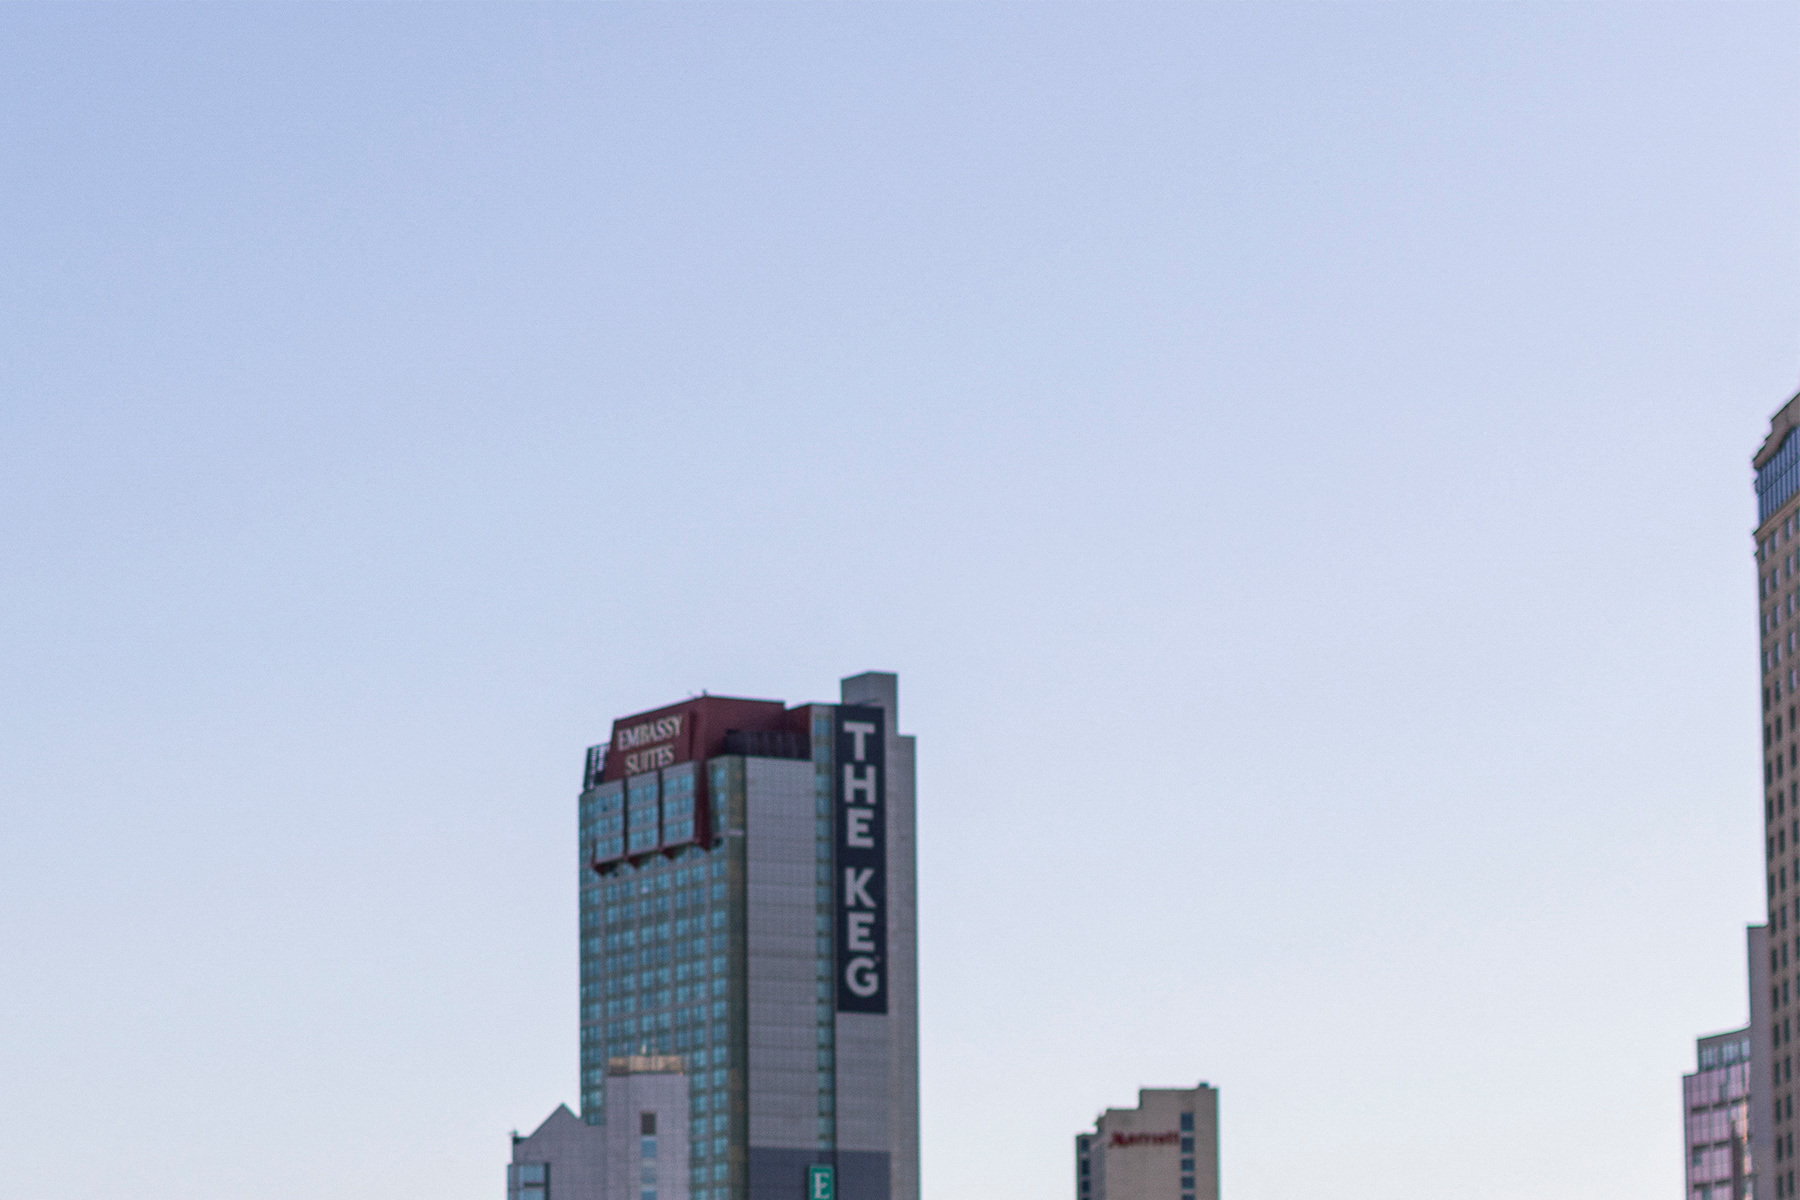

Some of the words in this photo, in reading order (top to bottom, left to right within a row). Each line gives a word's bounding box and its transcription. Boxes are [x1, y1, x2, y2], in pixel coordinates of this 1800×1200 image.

[617, 715, 683, 752] EMBASSY
[624, 743, 675, 776] SUITES
[844, 721, 877, 848] THE
[844, 867, 880, 998] KEG
[813, 1172, 830, 1200] E
